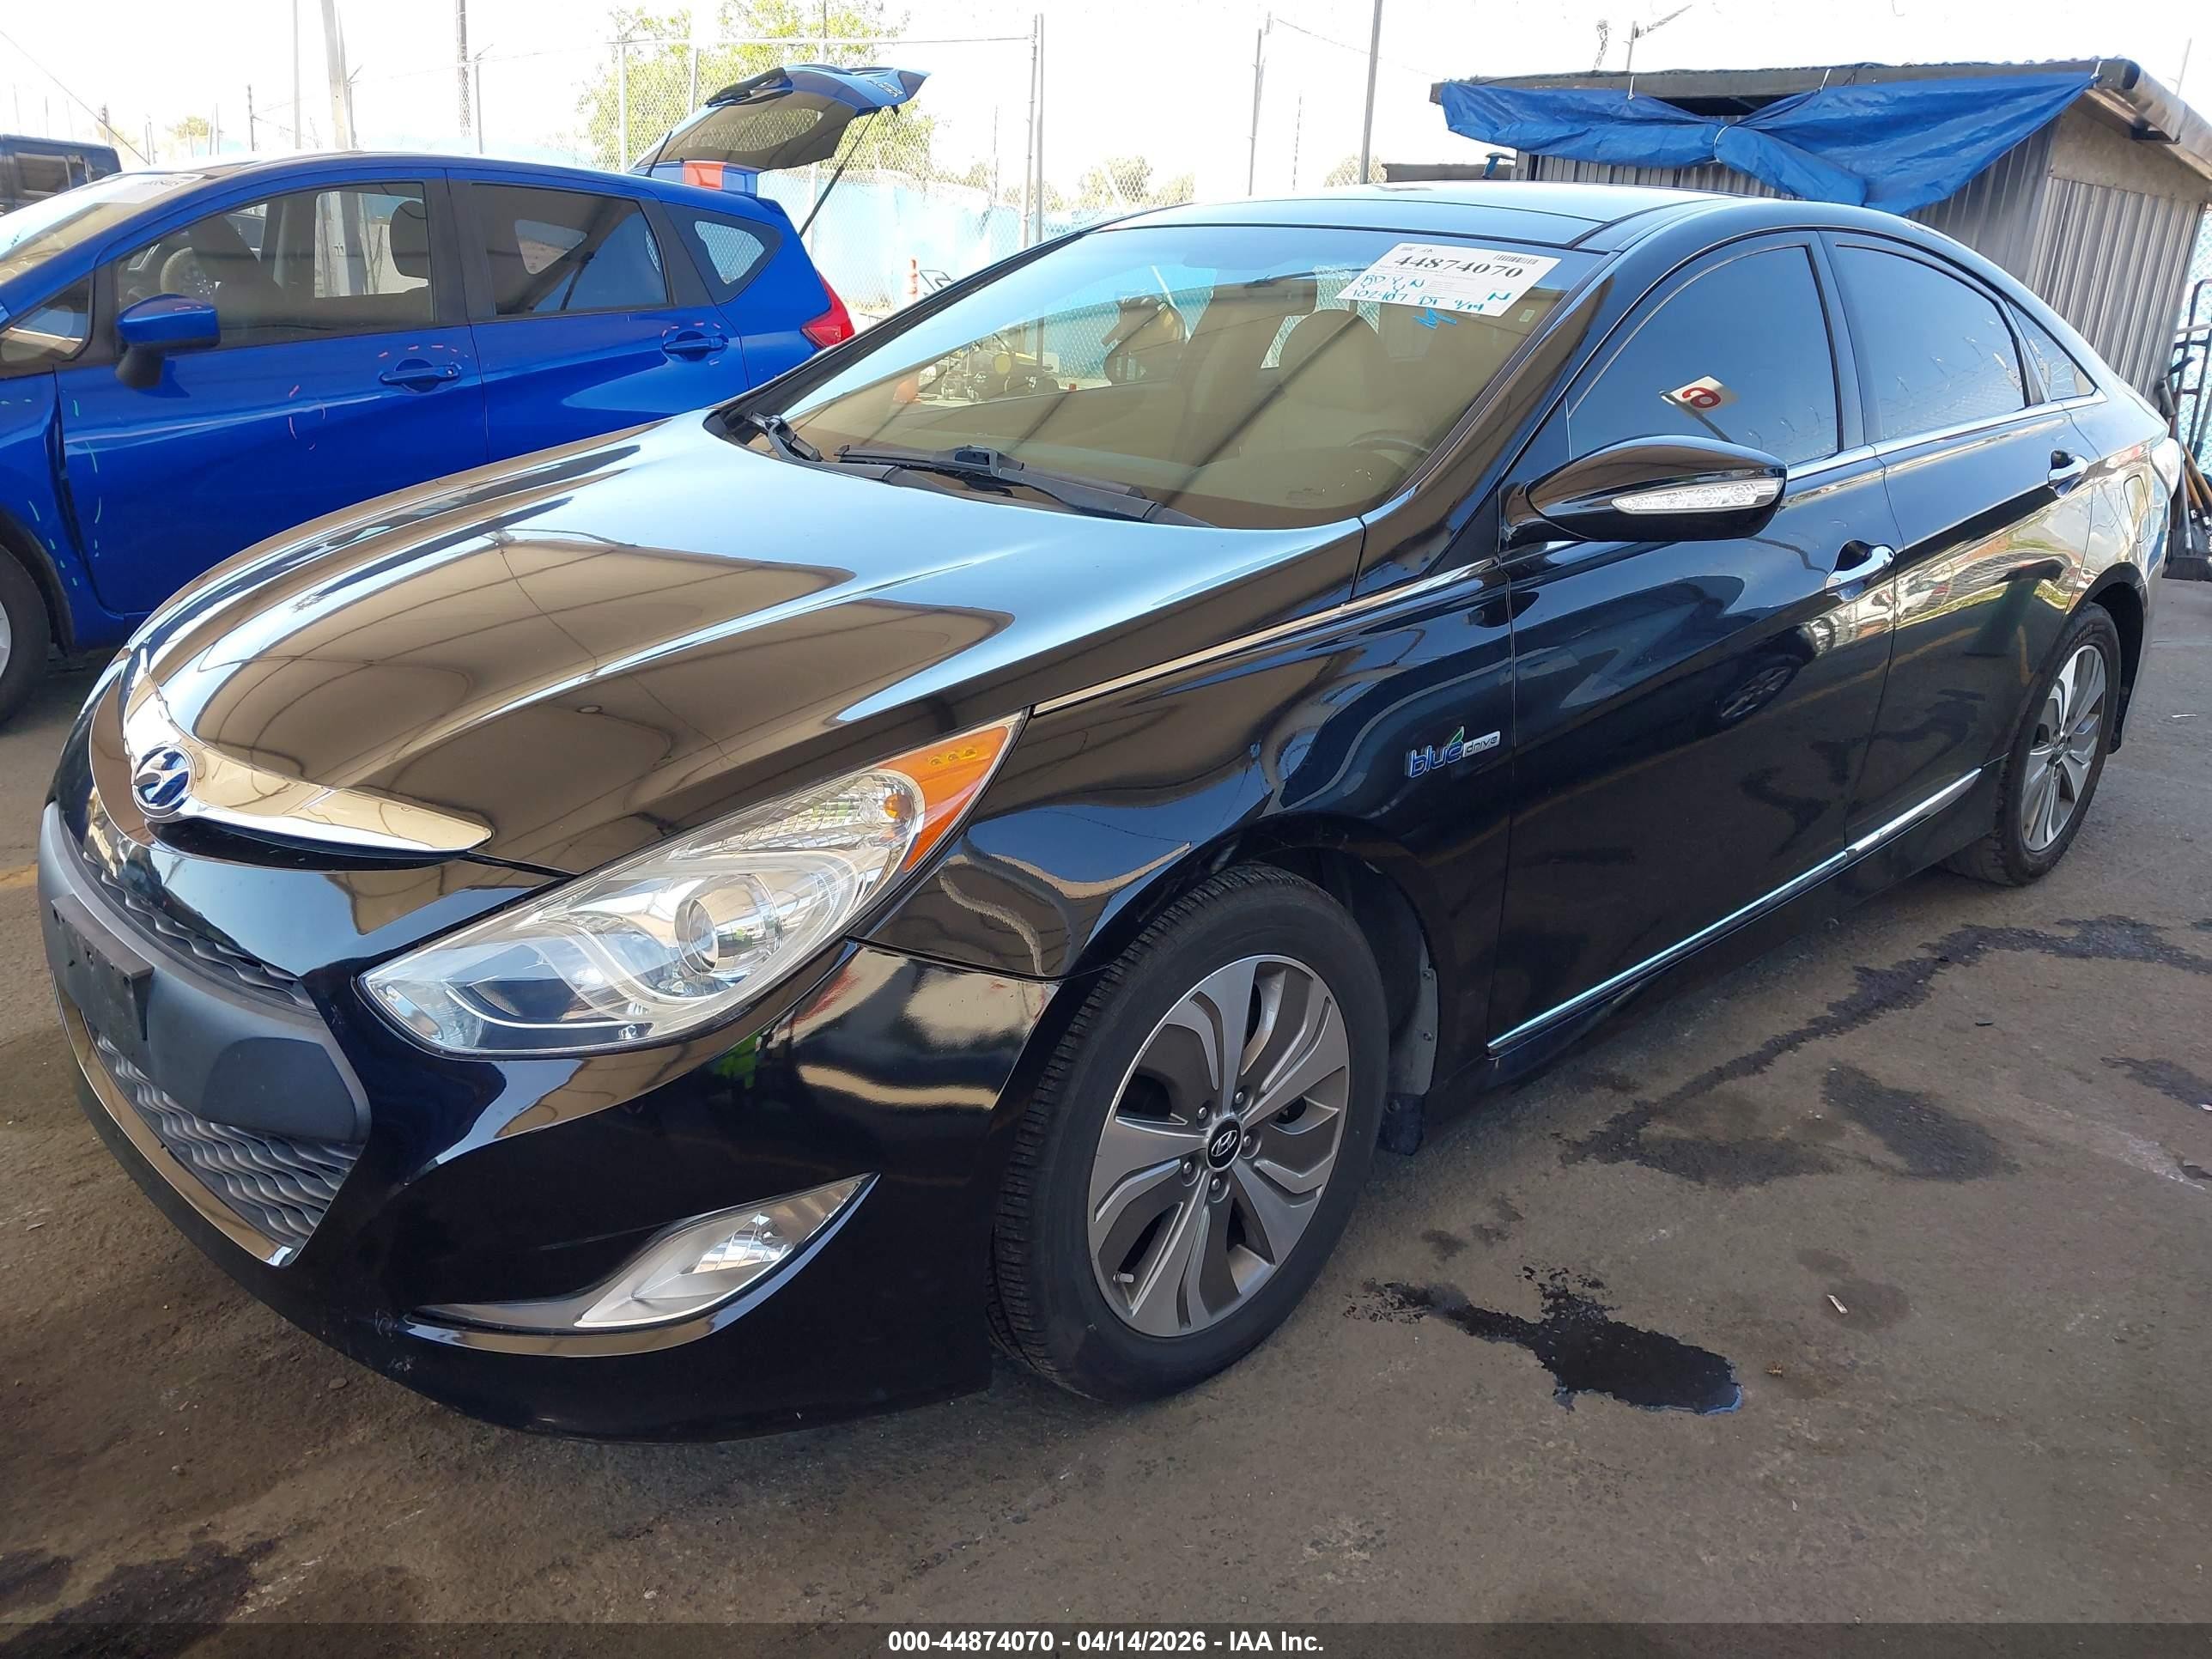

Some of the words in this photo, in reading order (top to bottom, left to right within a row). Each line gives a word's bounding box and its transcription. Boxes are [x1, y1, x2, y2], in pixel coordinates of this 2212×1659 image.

[1395, 256, 1523, 278] 44874070
[1410, 741, 1464, 778] blue
[1466, 736, 1498, 753] drive
